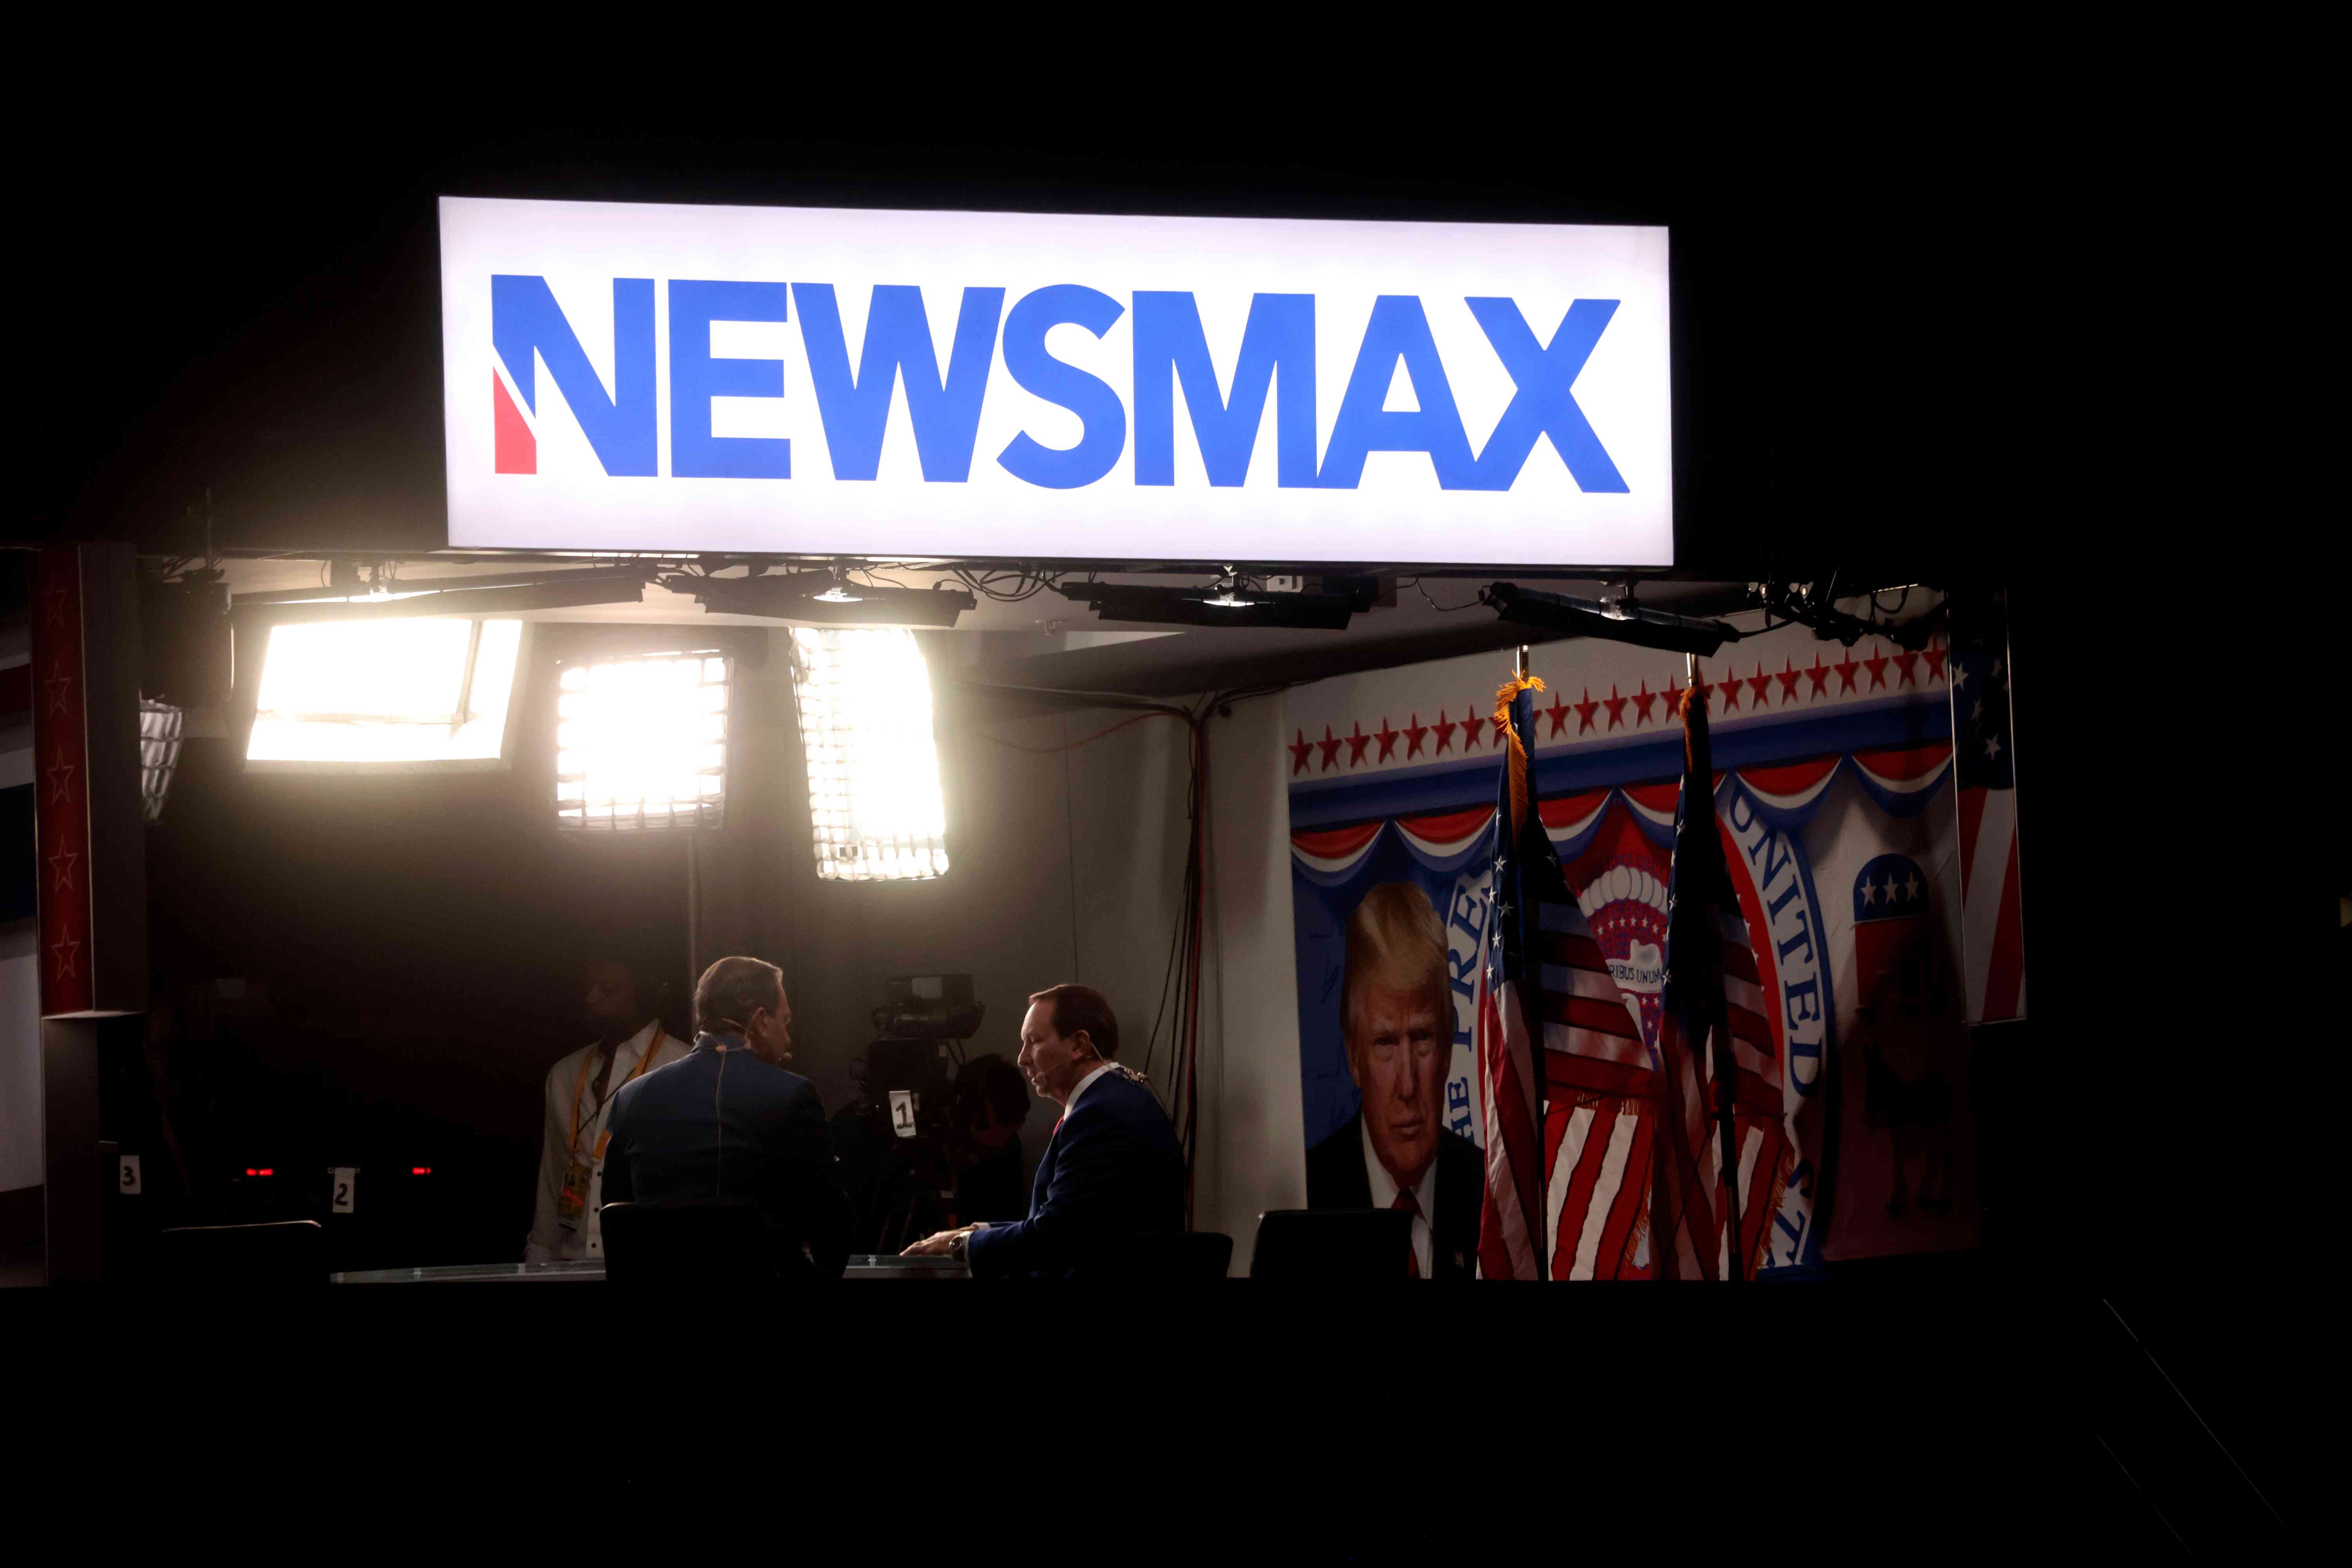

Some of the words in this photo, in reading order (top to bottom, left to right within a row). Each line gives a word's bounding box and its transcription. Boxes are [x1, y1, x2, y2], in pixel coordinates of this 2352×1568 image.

[492, 274, 1630, 493] NEWSMAX
[1448, 884, 1490, 1052] PRE
[1730, 785, 1821, 1097] UNITED
[896, 1102, 914, 1130] 1
[123, 1166, 135, 1187] 3
[335, 1183, 348, 1205] 2
[1767, 1160, 1814, 1267] ST
